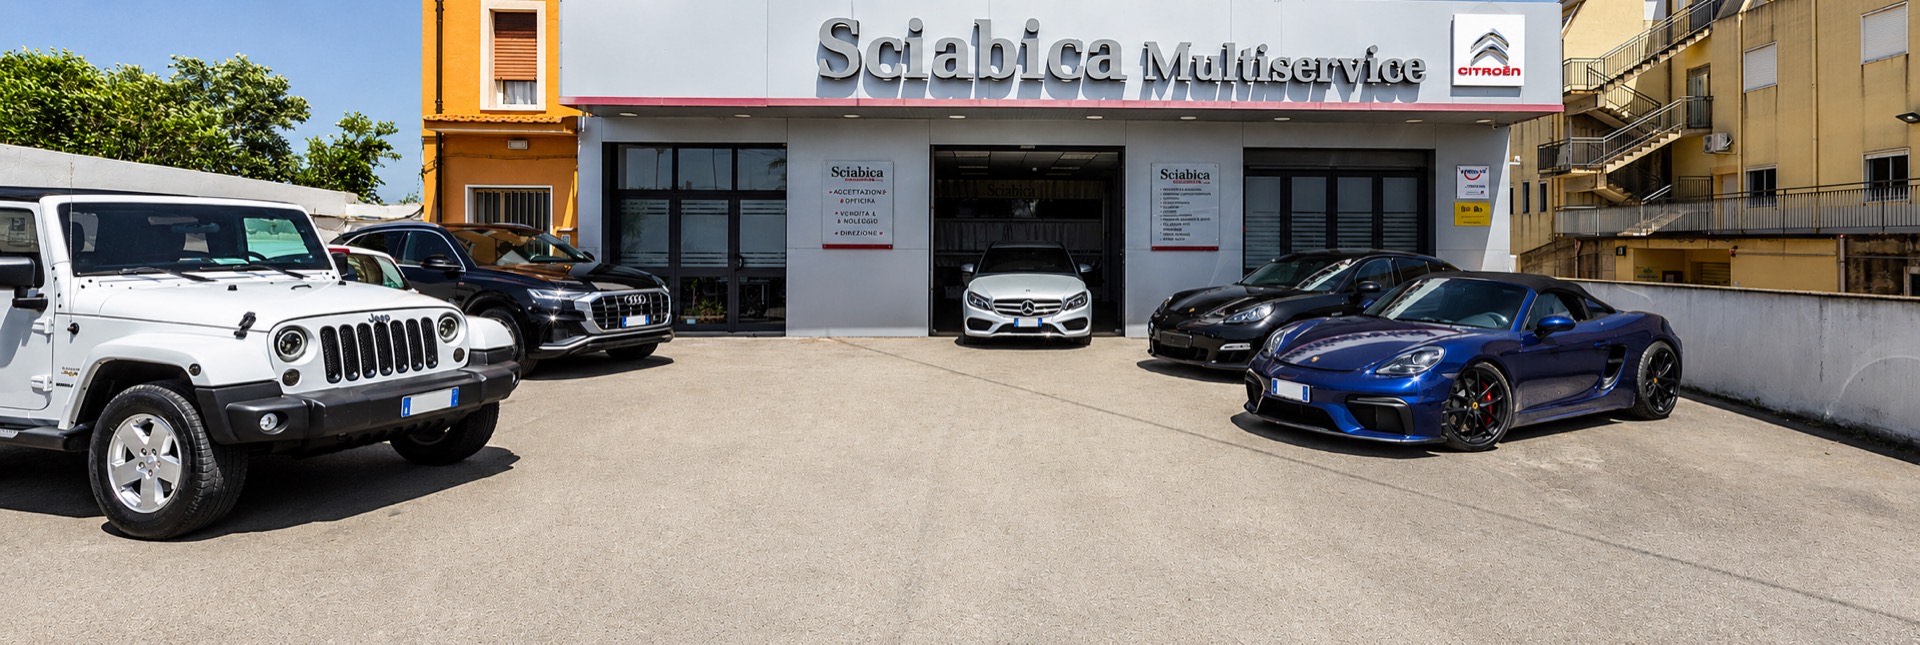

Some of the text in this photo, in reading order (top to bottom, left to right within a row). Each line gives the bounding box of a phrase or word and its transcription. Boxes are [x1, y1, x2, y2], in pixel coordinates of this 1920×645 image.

[818, 17, 1427, 85] Sciabica Multiservice
[831, 166, 884, 178] Sciabica
[1160, 168, 1210, 180] Sciabica
[987, 184, 1036, 197] Sciabica
[368, 313, 391, 323] Jeep
